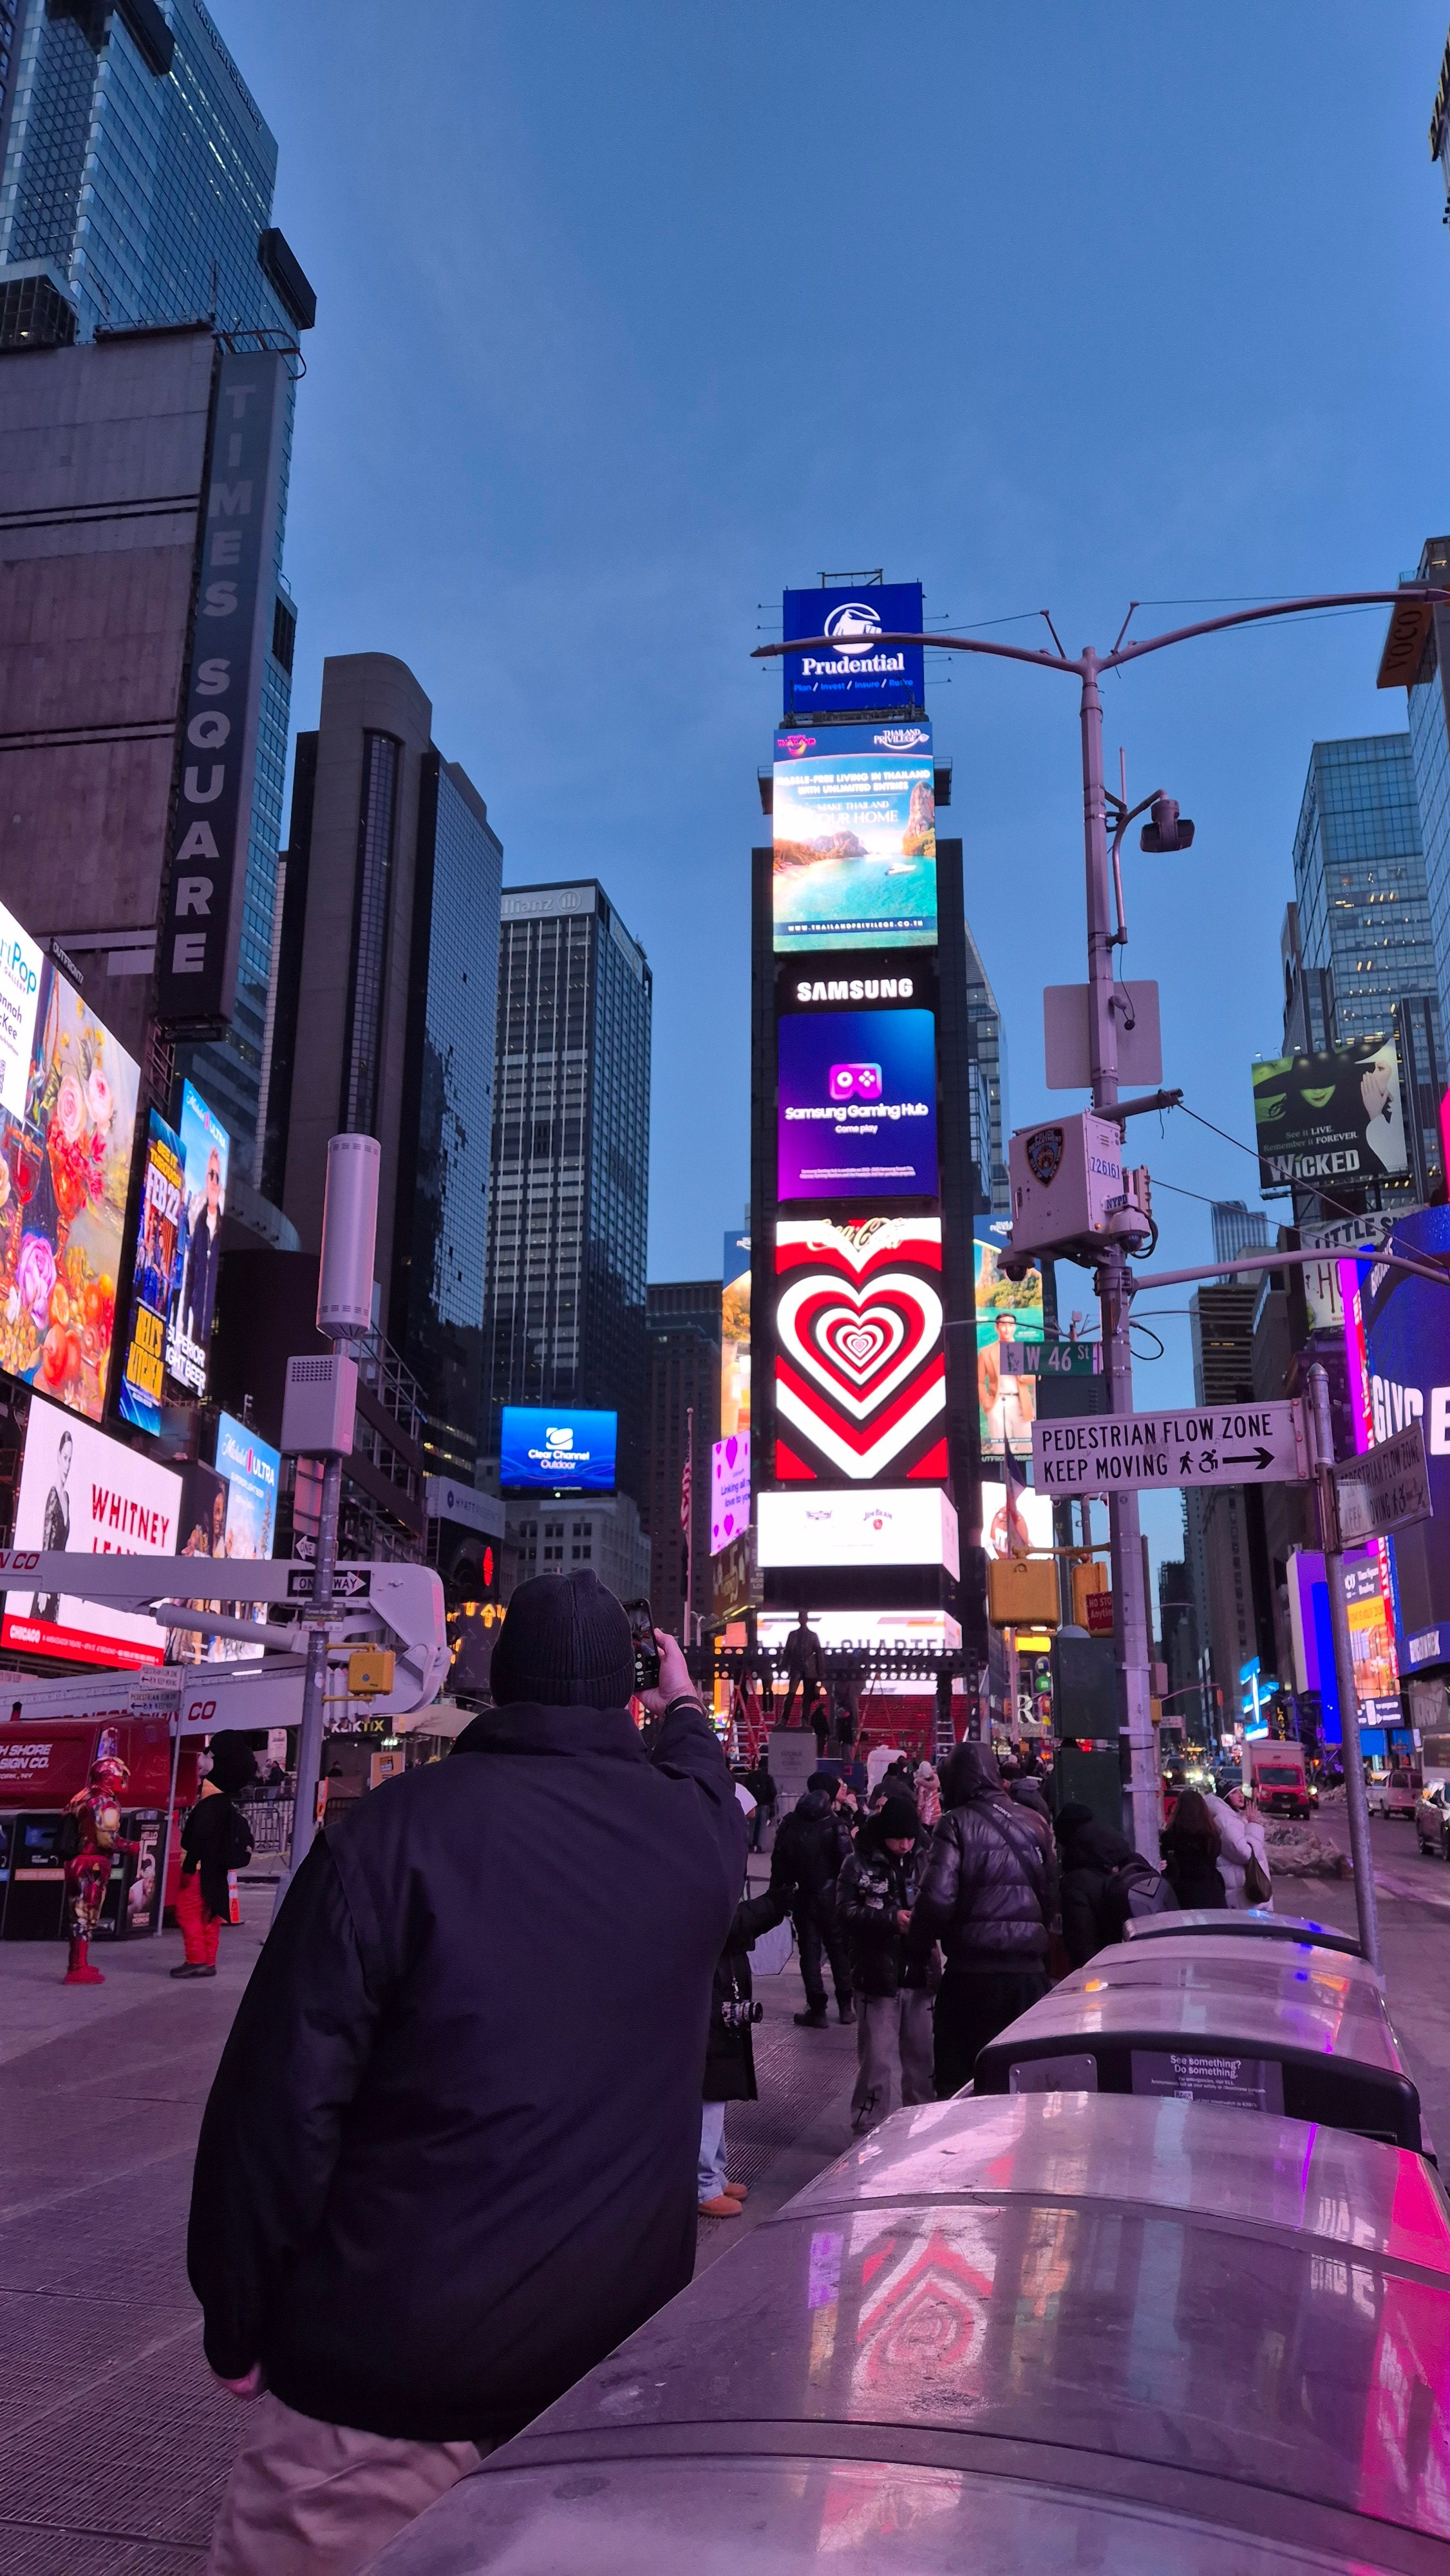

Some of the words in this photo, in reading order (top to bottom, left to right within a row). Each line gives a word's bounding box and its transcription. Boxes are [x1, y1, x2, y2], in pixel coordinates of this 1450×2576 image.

[203, 388, 256, 617] TIMES
[802, 652, 905, 676] Prudential
[854, 681, 880, 689] Insure
[883, 728, 921, 737] THAILAND
[836, 773, 869, 782] LIVING
[871, 772, 881, 781] IN
[883, 770, 931, 780] THAILAND
[798, 786, 820, 795] WITH
[822, 783, 871, 794] UNLIMITED
[873, 781, 909, 791] ENTRIES
[845, 800, 889, 810] THAILAND
[172, 659, 231, 973] SQUARE
[854, 810, 899, 823] HOME
[797, 978, 913, 1002] SAMSUNG
[785, 1106, 847, 1121] Samsung
[847, 1103, 901, 1120] Gaming
[901, 1103, 929, 1116] Hub
[209, 1124, 226, 1151] ULTRA
[835, 1125, 859, 1133] Come
[860, 1124, 878, 1135] play
[1263, 1140, 1306, 1151] Remember
[150, 1147, 182, 1190] THROUGH
[1091, 1157, 1120, 1180] 726161
[146, 1162, 168, 1213] FEB
[165, 1184, 180, 1227] 22
[1106, 1194, 1127, 1209] NYPD
[806, 1217, 906, 1252] Cca-Ca
[167, 1323, 206, 1368] SUPERIOR
[1026, 1347, 1040, 1371] W
[1048, 1347, 1072, 1372] 46
[1078, 1345, 1089, 1359] St
[185, 1359, 207, 1390] BEER
[1042, 1423, 1156, 1452] PEDESTRIAN
[1163, 1418, 1214, 1443] FLOW
[1222, 1413, 1274, 1438] ZONE
[528, 1449, 552, 1459] Clear
[553, 1450, 590, 1461] Channel
[1382, 1449, 1401, 1481] FLOW
[1401, 1435, 1420, 1470] ZONE
[253, 1456, 275, 1486] ULTRA
[541, 1459, 576, 1470] Outdoor
[1044, 1459, 1088, 1483] KEEP
[1096, 1453, 1168, 1480] MOVING
[720, 1482, 739, 1496] Linking
[724, 1498, 735, 1508] love
[736, 1495, 741, 1504] to
[1369, 1492, 1391, 1526] OVING
[92, 1483, 170, 1548] WHITNEY
[12, 1553, 40, 1569] CO
[334, 1578, 357, 1589] WAY
[1089, 1598, 1098, 1608] NO
[1100, 1596, 1112, 1606] STO
[10, 1624, 41, 1643] CHICAGO
[187, 1701, 216, 1721] CO
[8, 1743, 53, 1757] SHORE
[0, 1757, 30, 1770] SIGN
[1171, 2055, 1187, 2065] See
[1189, 2058, 1241, 2070] something?
[1174, 2064, 1187, 2074] Do
[1189, 2065, 1239, 2079] something.
